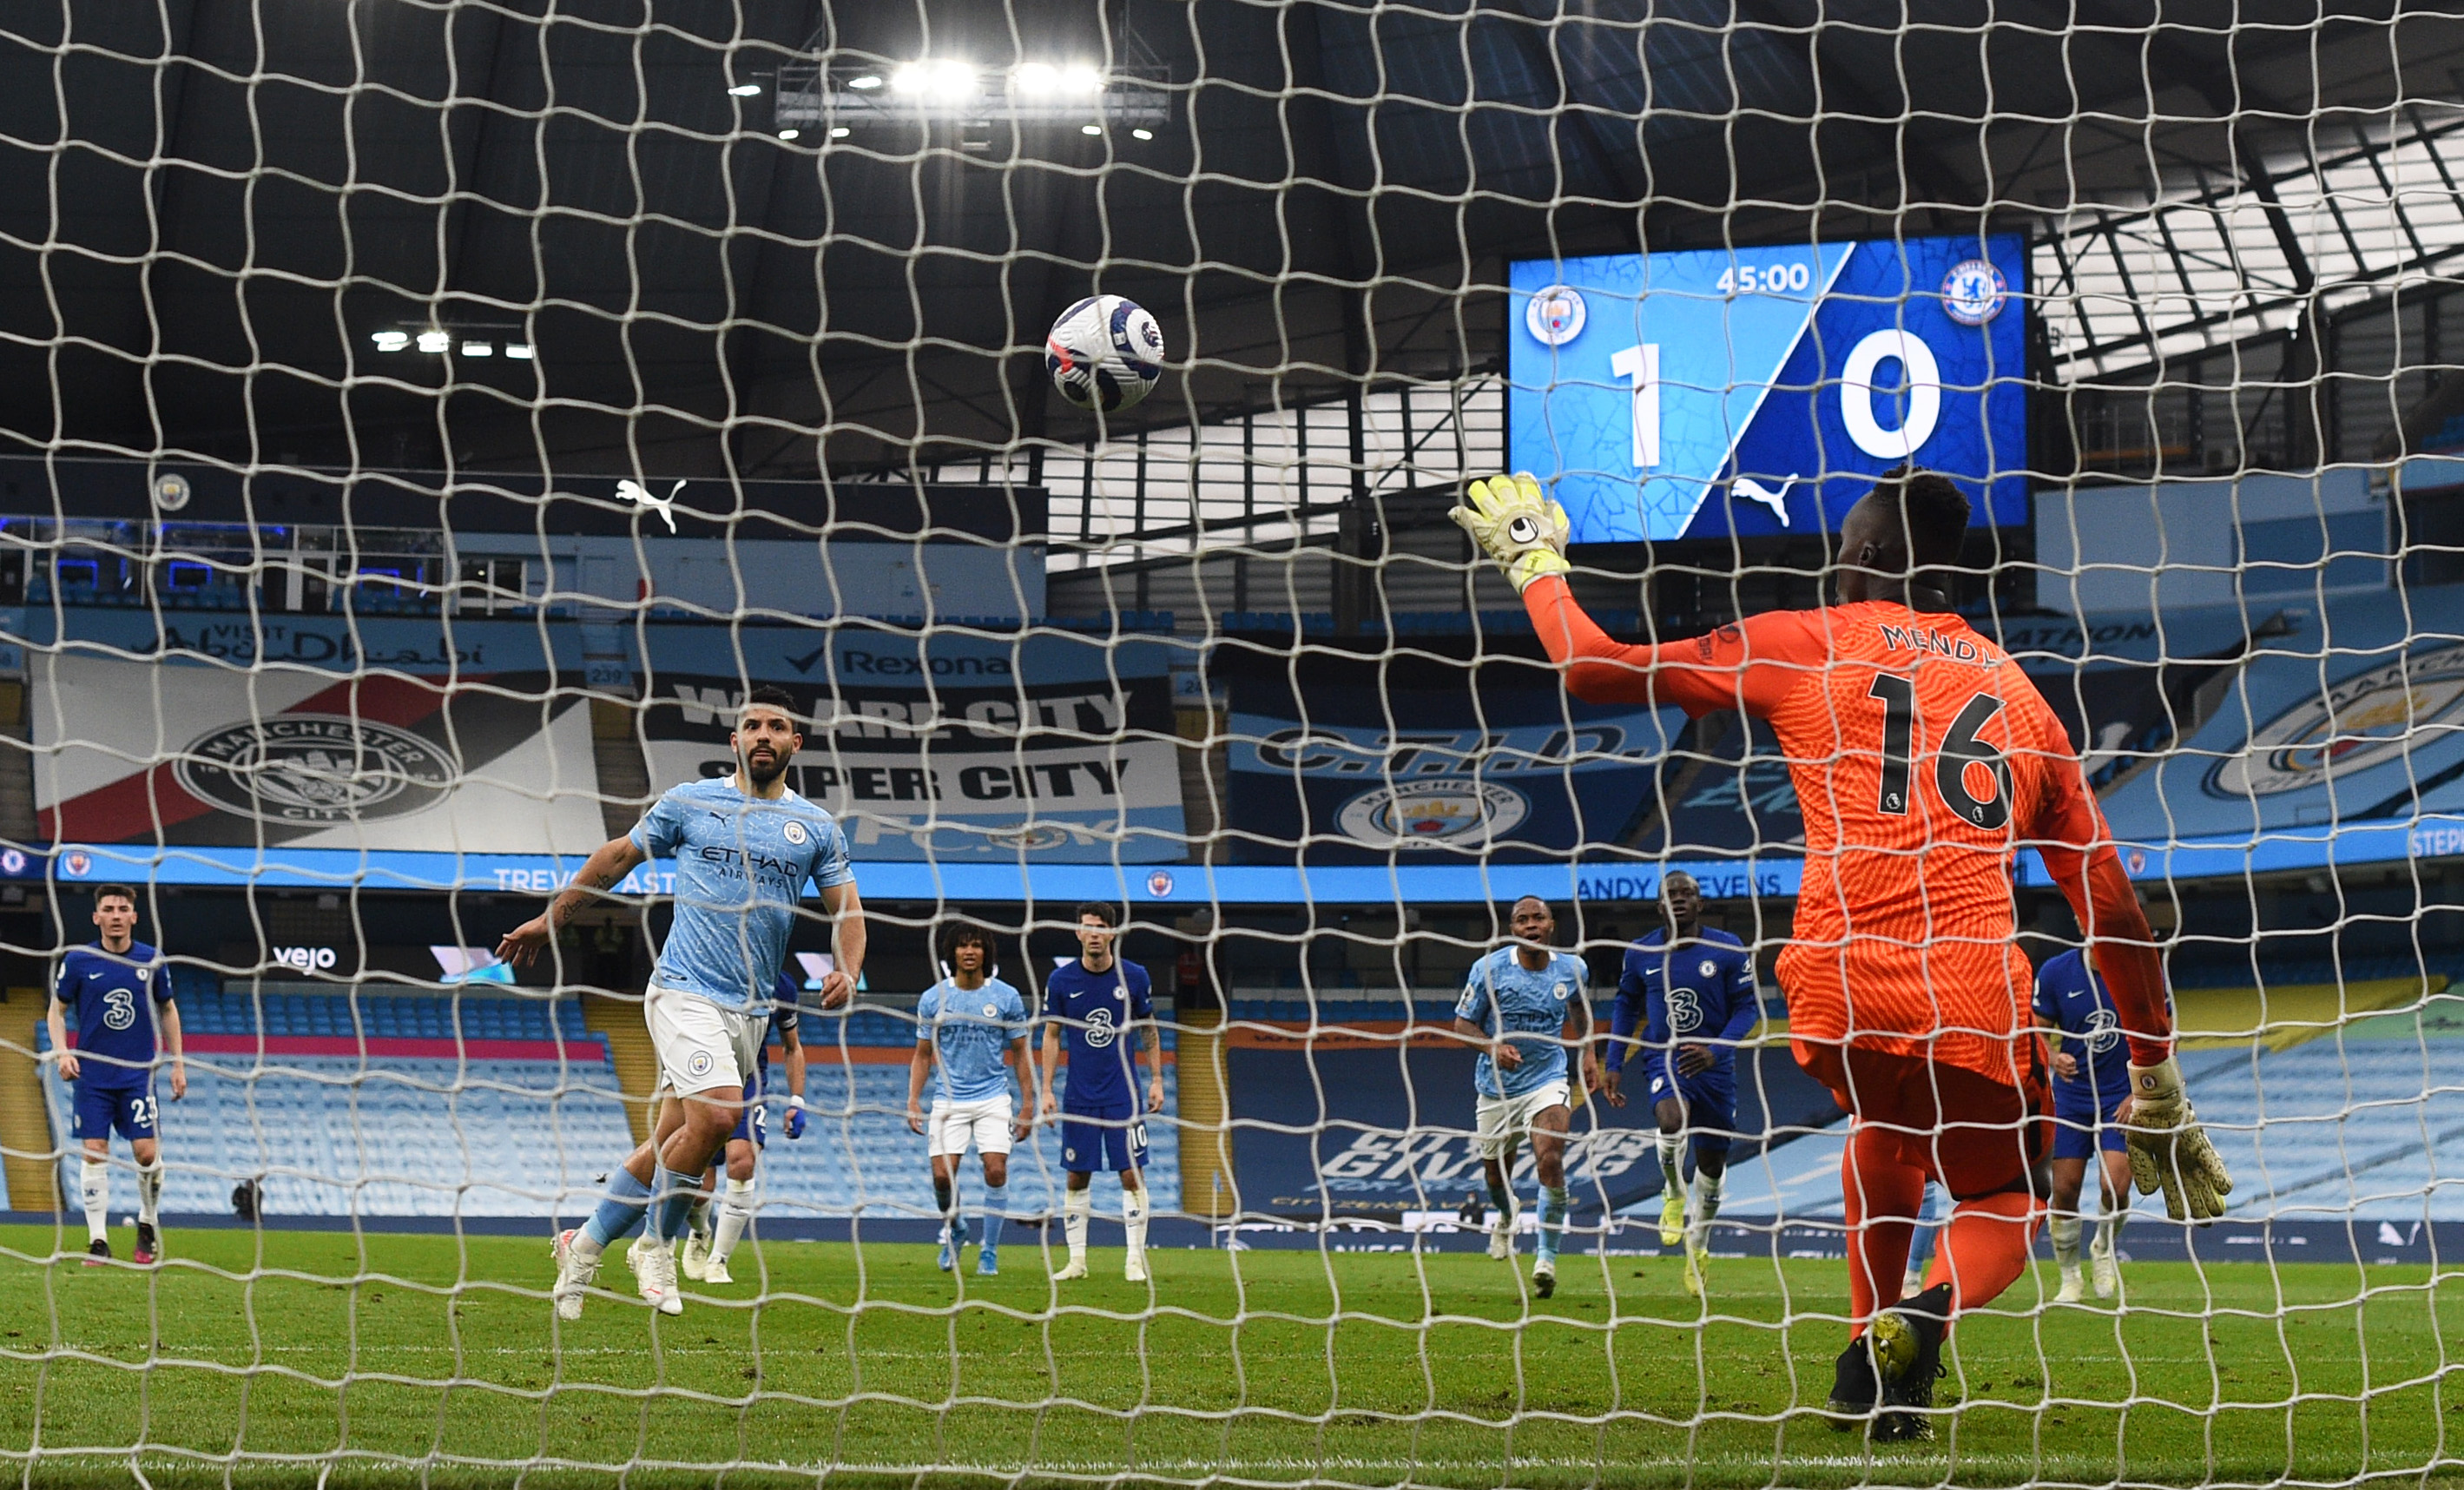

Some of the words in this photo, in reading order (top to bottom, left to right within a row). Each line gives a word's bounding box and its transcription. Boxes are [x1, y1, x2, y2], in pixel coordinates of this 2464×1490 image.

[1716, 262, 1809, 293] 45:00
[1611, 343, 1660, 468] 1
[1840, 328, 1941, 459] 0
[843, 651, 1011, 676] Rexona
[1878, 623, 1999, 673] MENDY
[809, 697, 952, 739] ARE
[965, 691, 1133, 739] CITY
[206, 721, 426, 764] MANCHESTER
[1868, 671, 2015, 831] 16
[959, 758, 1130, 801] CITY
[281, 807, 363, 821] CITY
[702, 846, 799, 878] ETIHAD
[1576, 876, 1652, 900] ANDY
[273, 946, 337, 977] vejo
